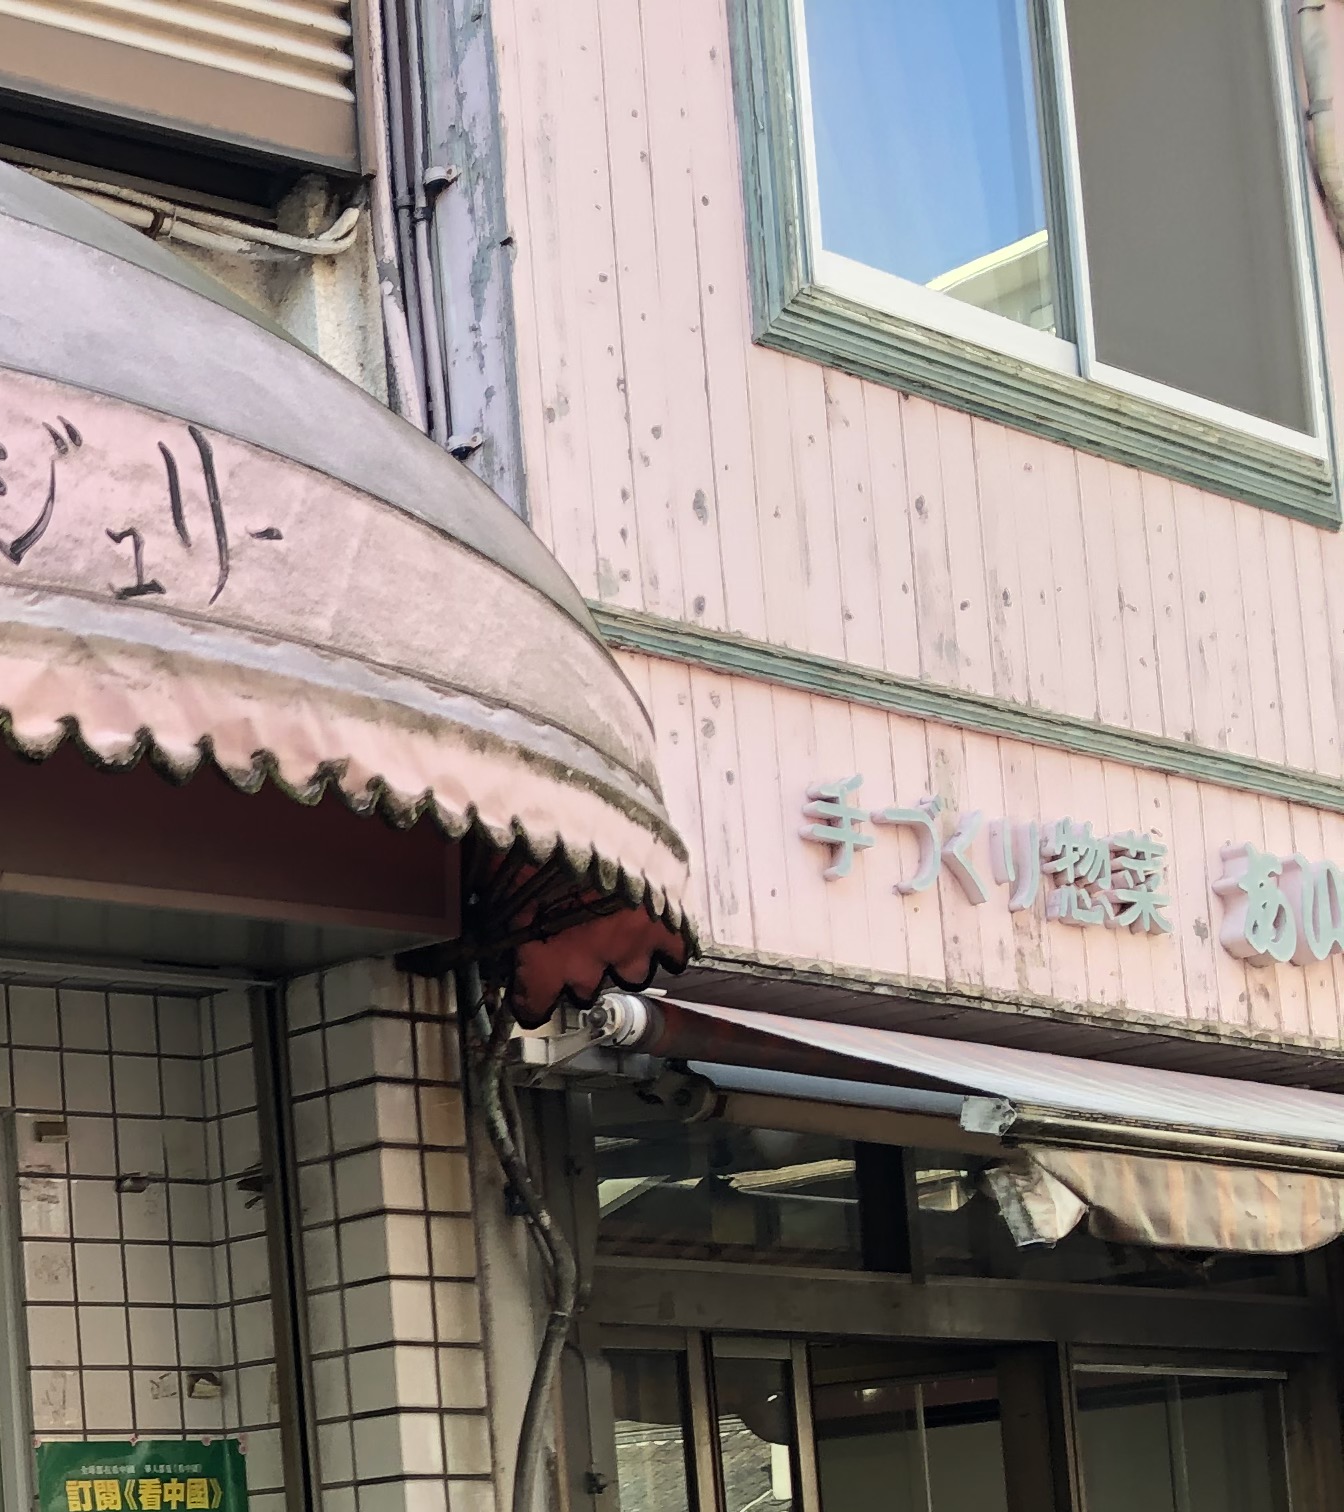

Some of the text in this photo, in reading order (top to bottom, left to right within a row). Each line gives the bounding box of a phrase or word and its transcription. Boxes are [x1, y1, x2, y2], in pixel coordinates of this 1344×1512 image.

[800, 773, 1175, 936] 手づくり惣菜
